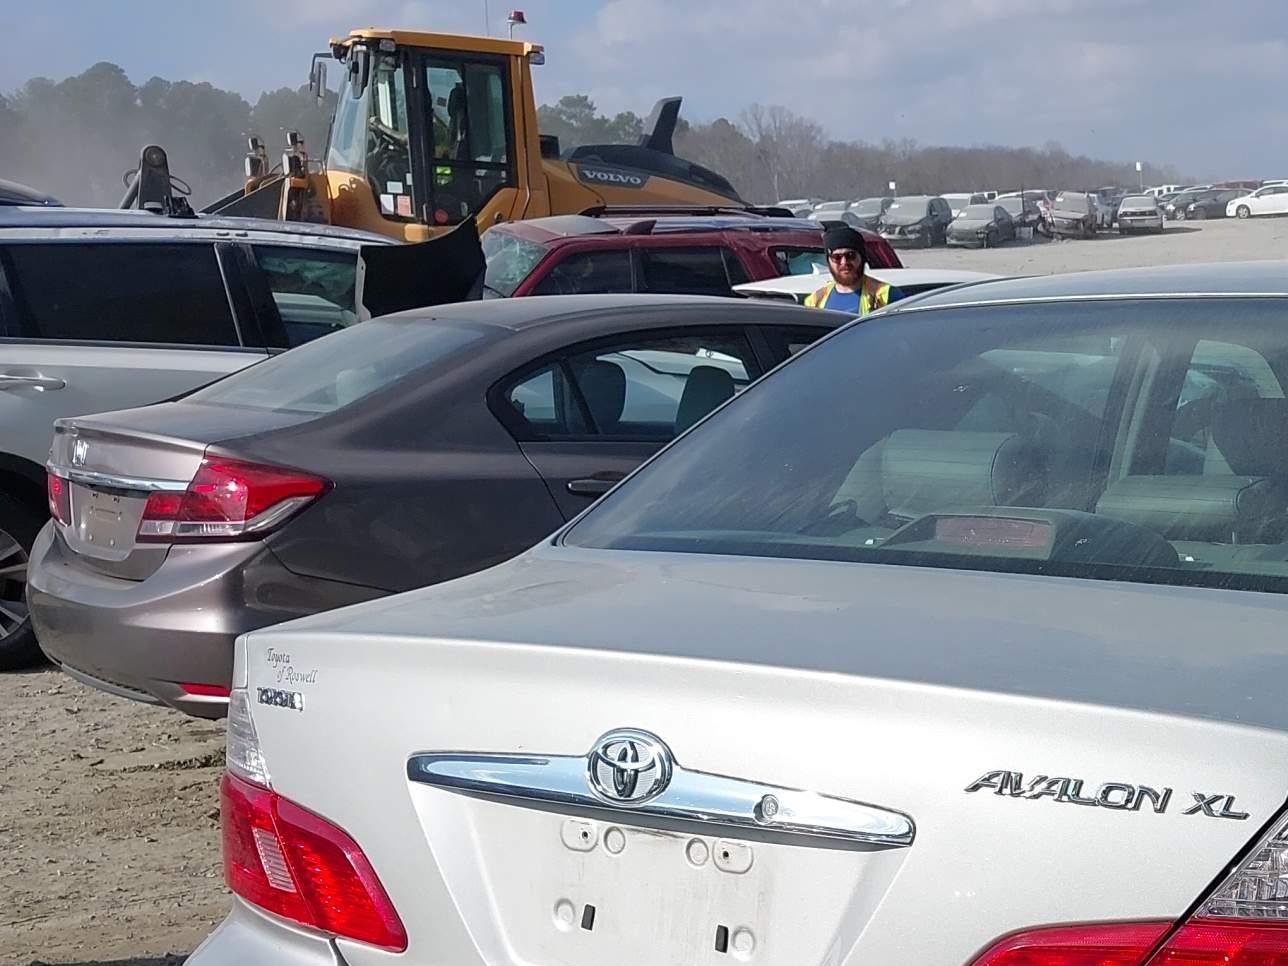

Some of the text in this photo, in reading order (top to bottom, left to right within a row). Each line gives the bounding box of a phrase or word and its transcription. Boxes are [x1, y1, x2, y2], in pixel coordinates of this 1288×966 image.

[582, 169, 642, 185] VOLVO
[267, 647, 291, 668] Toyota
[276, 665, 319, 685] of Roswell
[963, 769, 1251, 821] AVALON XL
